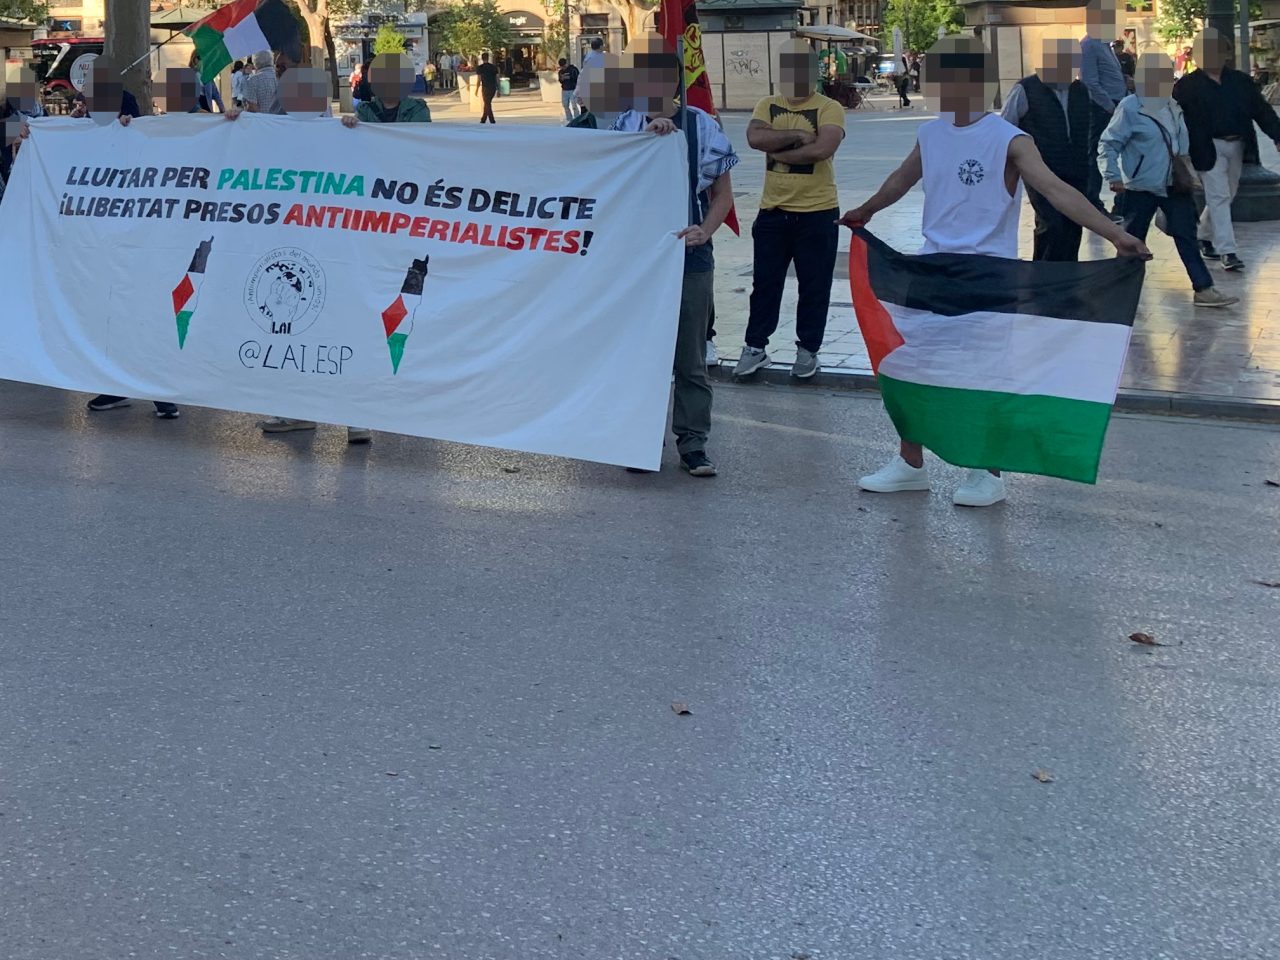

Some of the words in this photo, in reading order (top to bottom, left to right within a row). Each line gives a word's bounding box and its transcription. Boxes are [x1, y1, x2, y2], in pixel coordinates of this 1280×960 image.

[66, 166, 158, 189] LLUITAR
[160, 167, 210, 190] PER
[216, 168, 365, 196] PALESTINA
[371, 178, 418, 204] NO
[424, 178, 463, 209] ÉS
[467, 188, 596, 220] DELICTE
[183, 199, 281, 225] PRESOS
[282, 203, 594, 256] ANTIIMPERIALISTES!
[272, 321, 292, 334] LAI
[238, 340, 353, 375] @LAI.ESP
